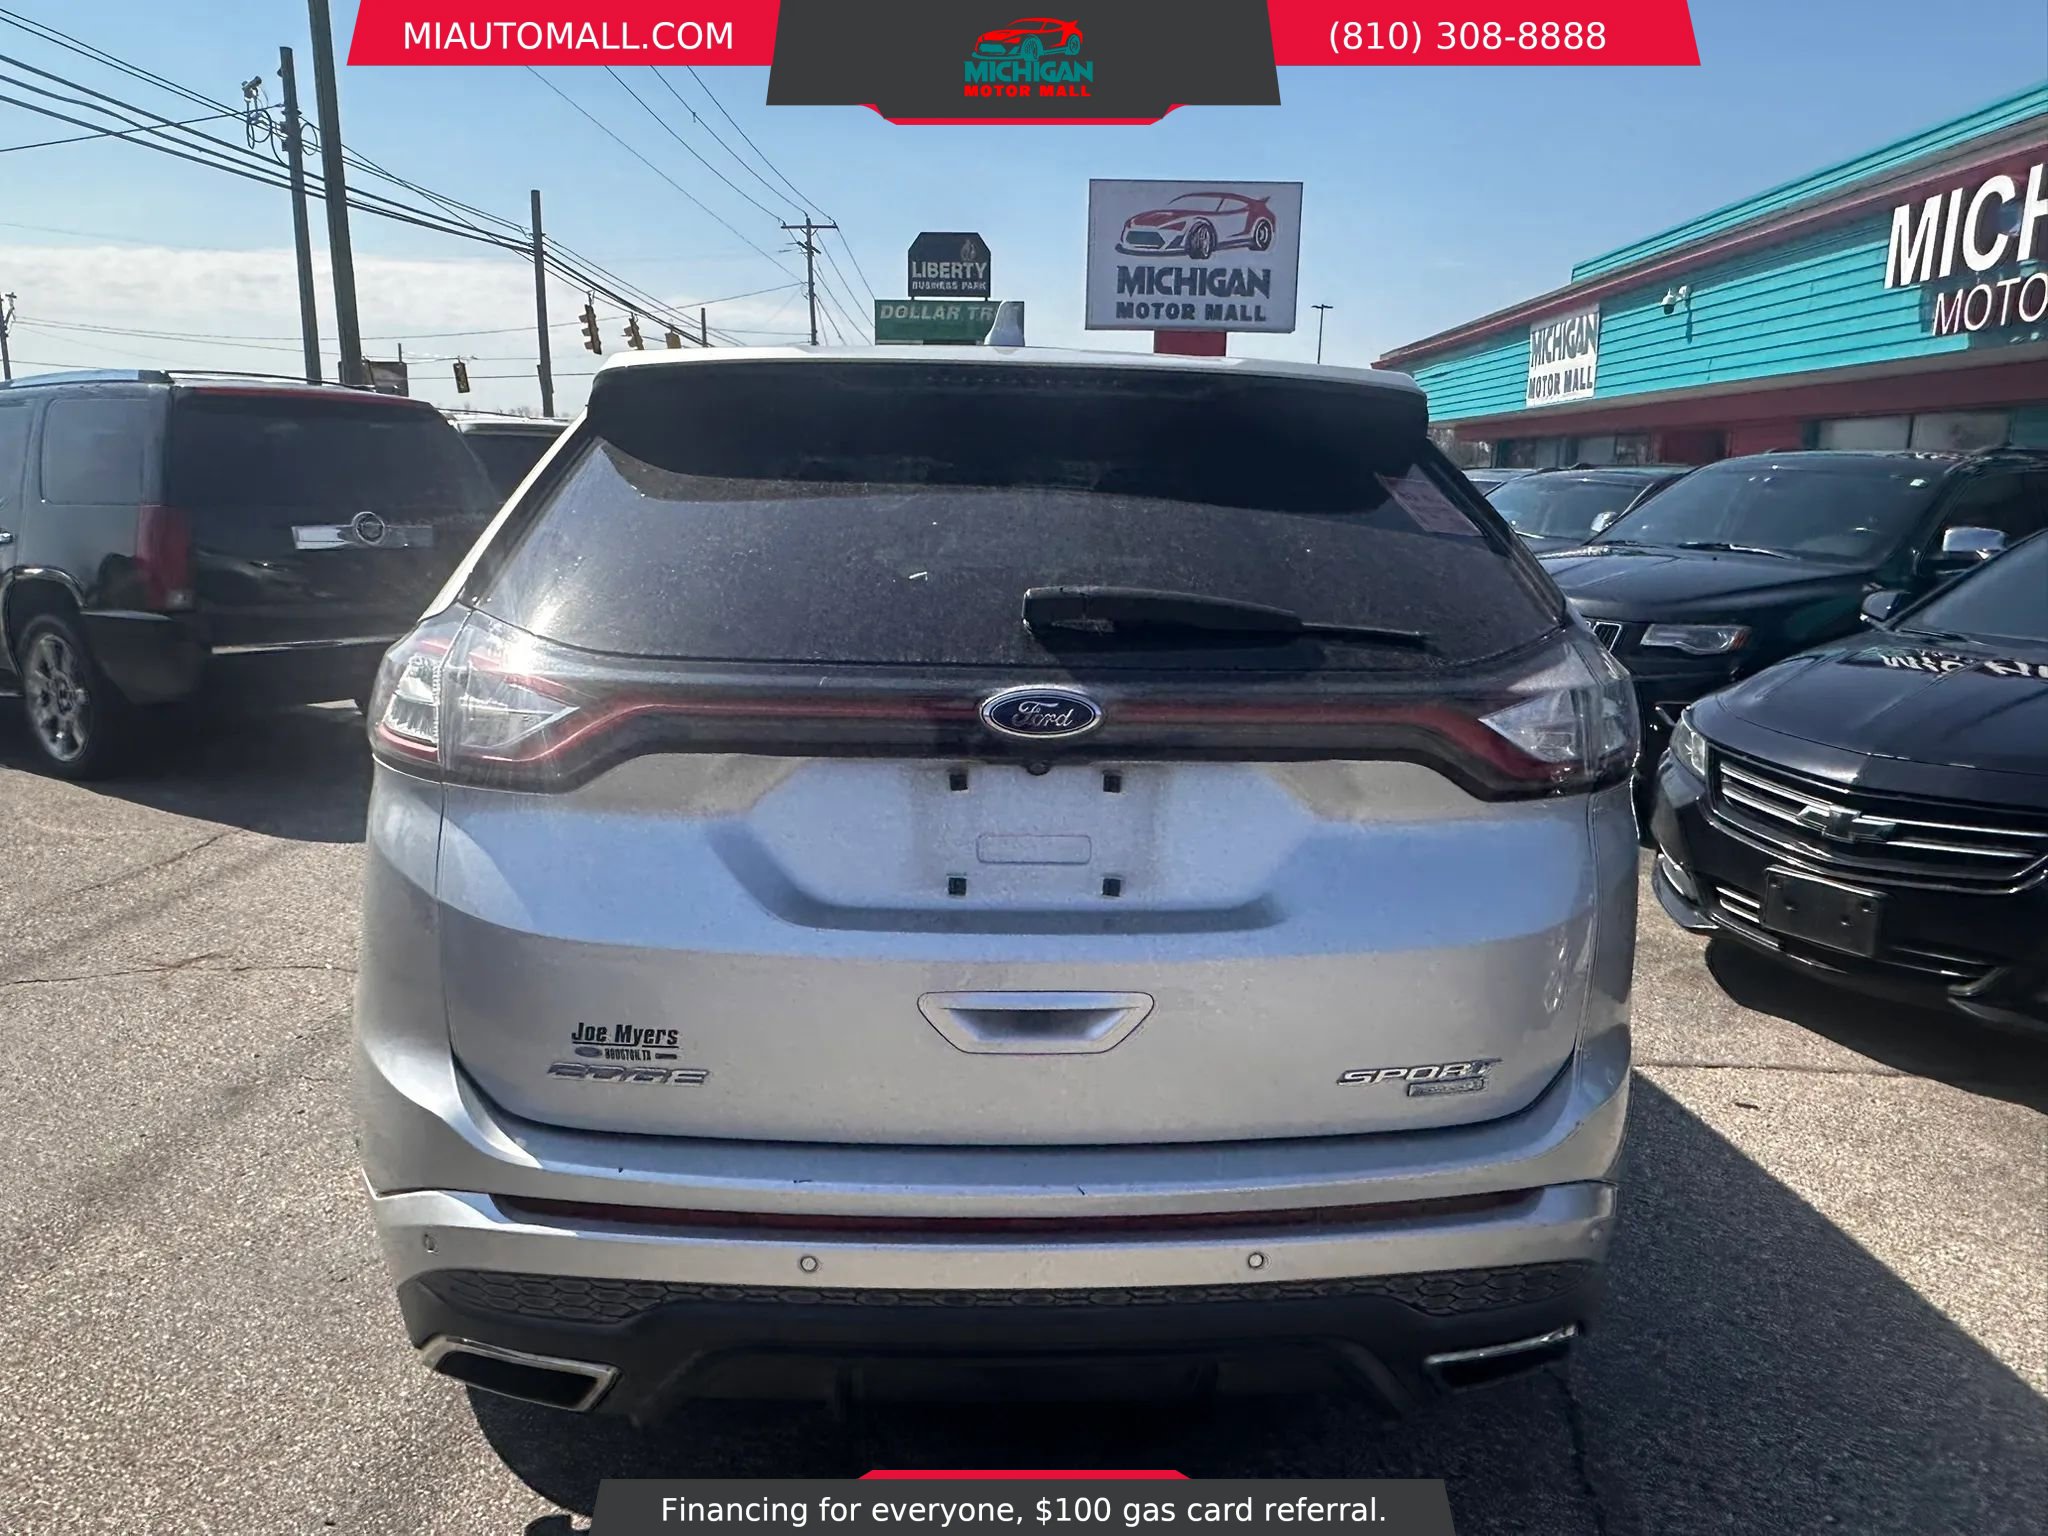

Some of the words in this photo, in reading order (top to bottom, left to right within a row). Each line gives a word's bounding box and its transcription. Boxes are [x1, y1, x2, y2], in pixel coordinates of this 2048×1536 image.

[911, 260, 988, 280] LIBERTY
[1117, 265, 1271, 299] MICHIGAN
[911, 281, 959, 291] BUSINESS
[961, 281, 987, 292] PARK
[880, 304, 961, 321] DOLLAR
[1115, 302, 1196, 320] MOTOR
[1204, 303, 1267, 322] MALL
[1530, 312, 1599, 370] MICHIGAN
[1528, 372, 1560, 400] MOTOR
[1563, 365, 1593, 394] MALL
[1011, 700, 1075, 727] Ford
[571, 1022, 608, 1042] Joe
[614, 1024, 679, 1047] Myers
[1337, 1057, 1502, 1086] SPORT
